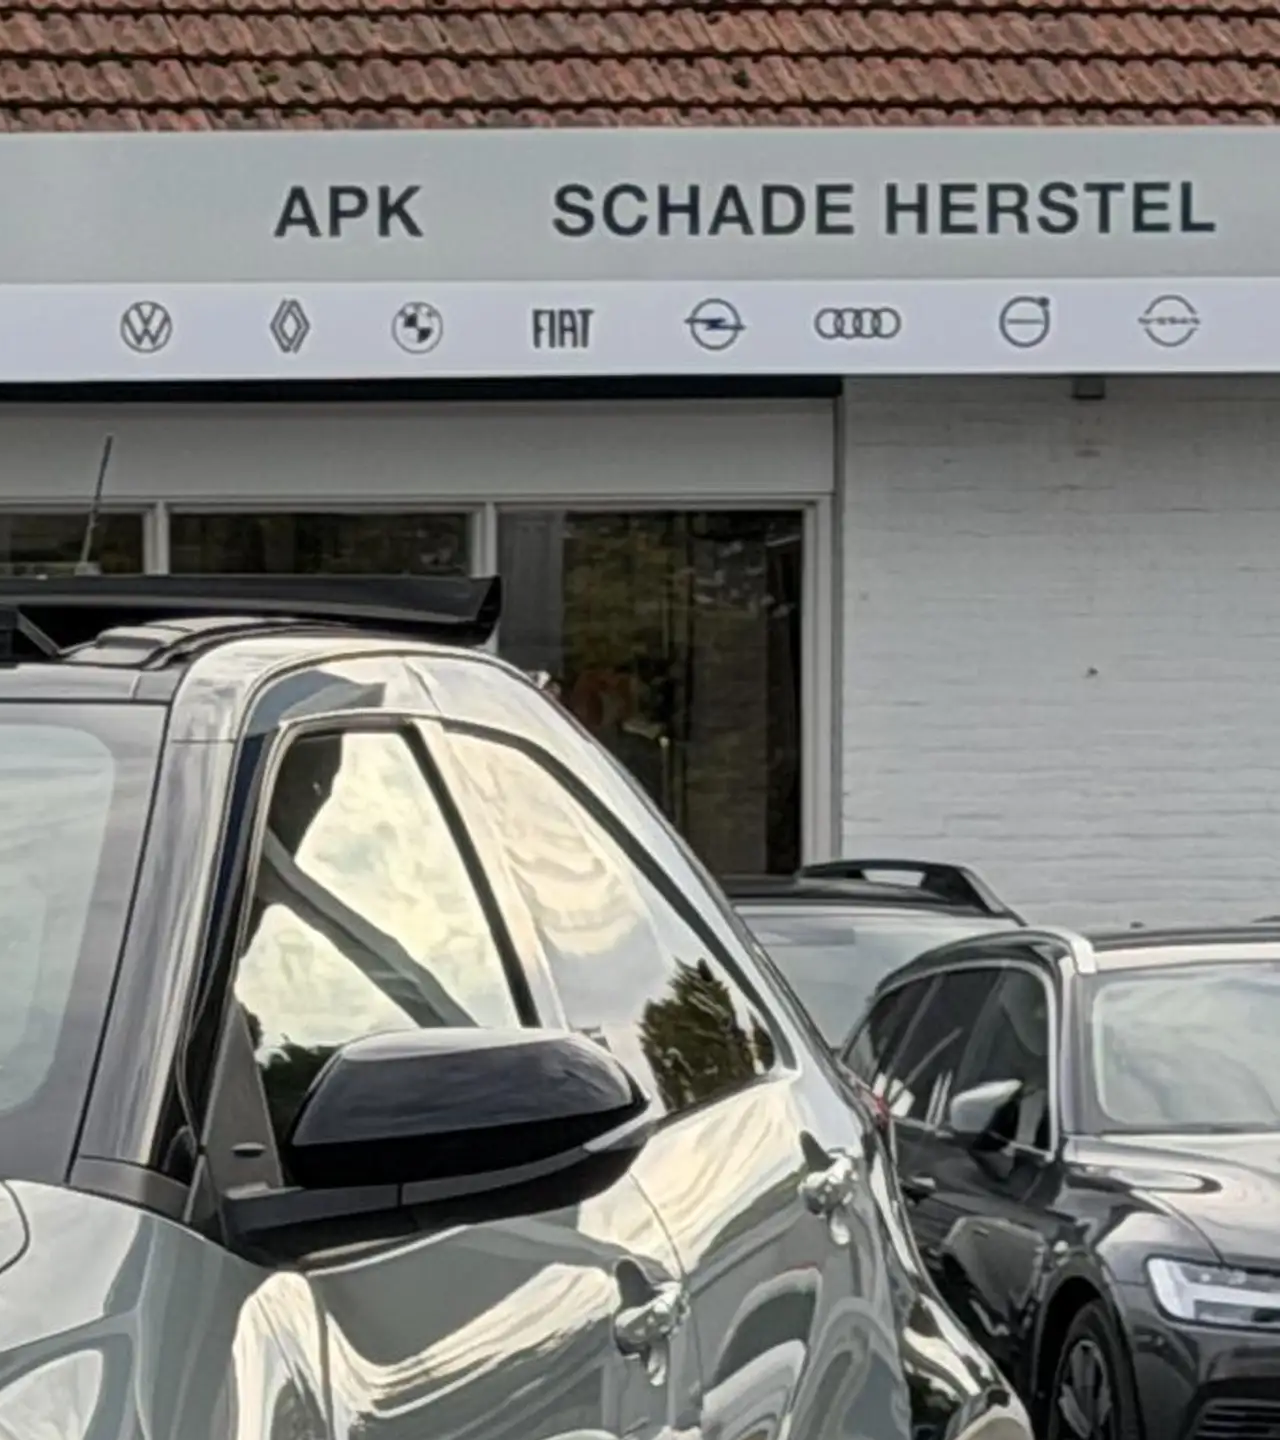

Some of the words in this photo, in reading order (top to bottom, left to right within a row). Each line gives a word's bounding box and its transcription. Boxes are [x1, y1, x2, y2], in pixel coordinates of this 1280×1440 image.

[273, 185, 424, 238] APK
[552, 183, 854, 237] SCHADE
[886, 181, 1217, 235] HERSTEL
[532, 309, 595, 349] FIAT
